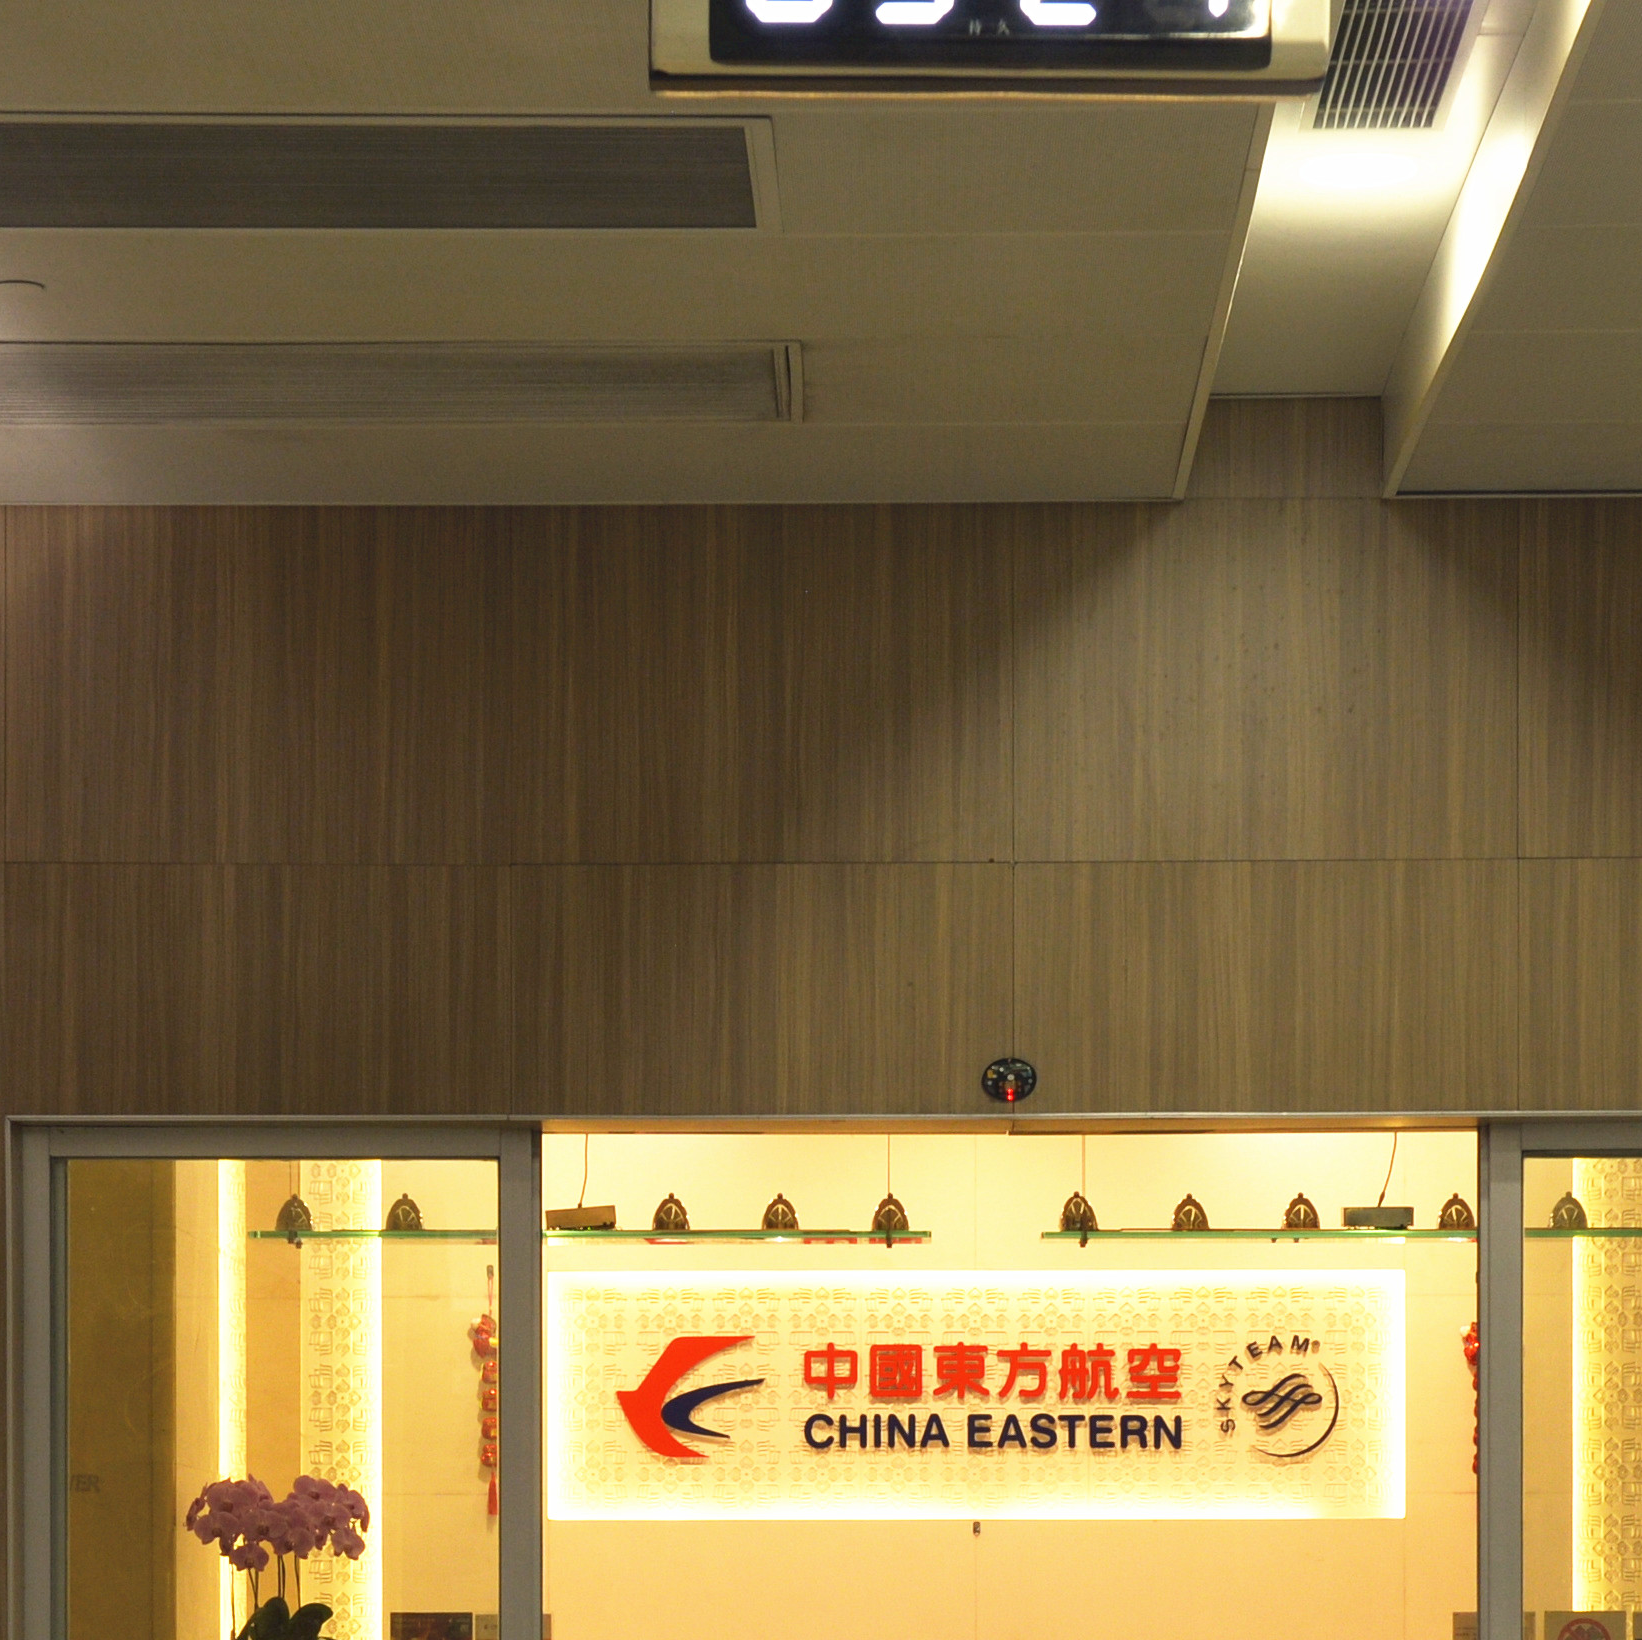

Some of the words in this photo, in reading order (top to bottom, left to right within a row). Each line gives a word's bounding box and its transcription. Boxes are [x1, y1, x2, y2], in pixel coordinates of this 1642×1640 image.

[803, 1341, 1182, 1401] 中國東方航空
[1216, 1334, 1311, 1434] SKYTEAM
[803, 1412, 951, 1450] CHINA
[966, 1412, 1183, 1451] EASTERN
